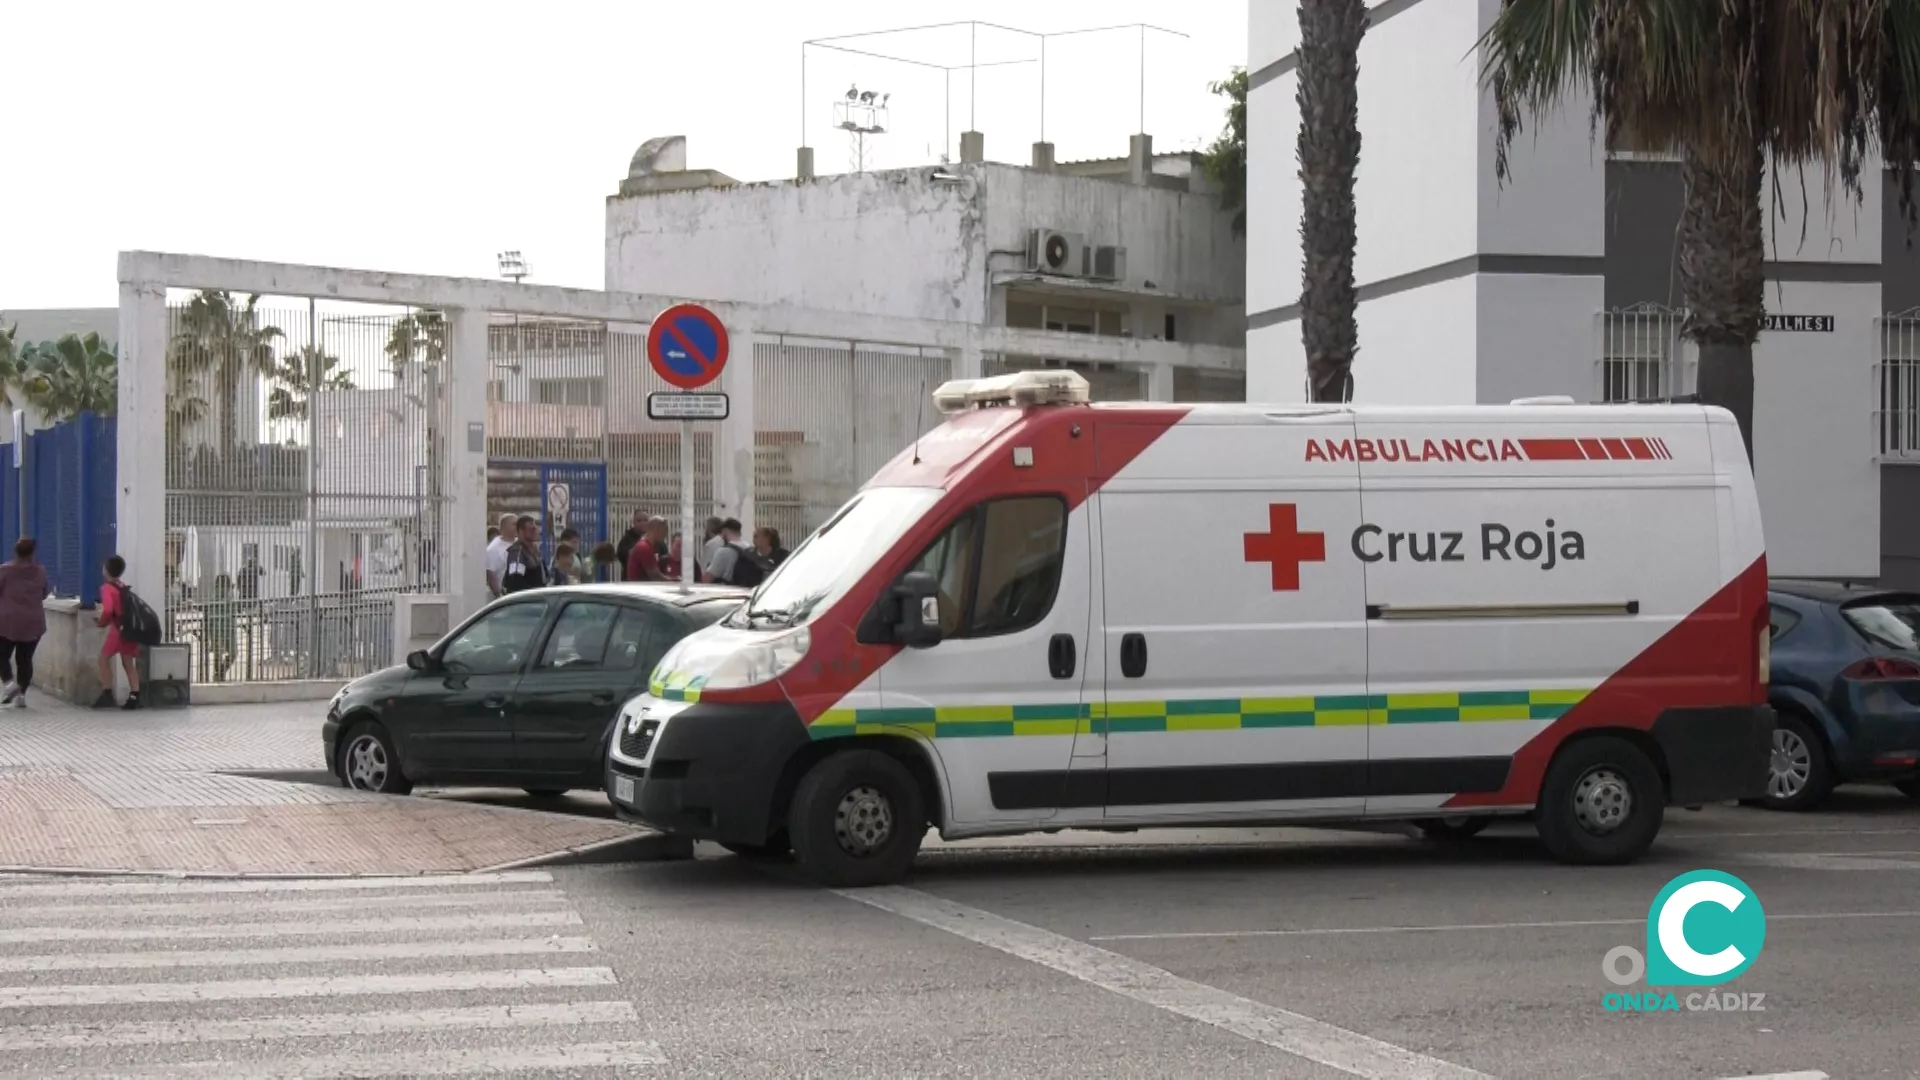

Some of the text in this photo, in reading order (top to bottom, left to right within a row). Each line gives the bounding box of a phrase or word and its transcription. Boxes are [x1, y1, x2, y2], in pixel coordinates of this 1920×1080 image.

[1758, 315, 1832, 331] DALMESI
[1305, 438, 1523, 462] AMBULANCIA
[1351, 518, 1585, 570] Cruz Roja
